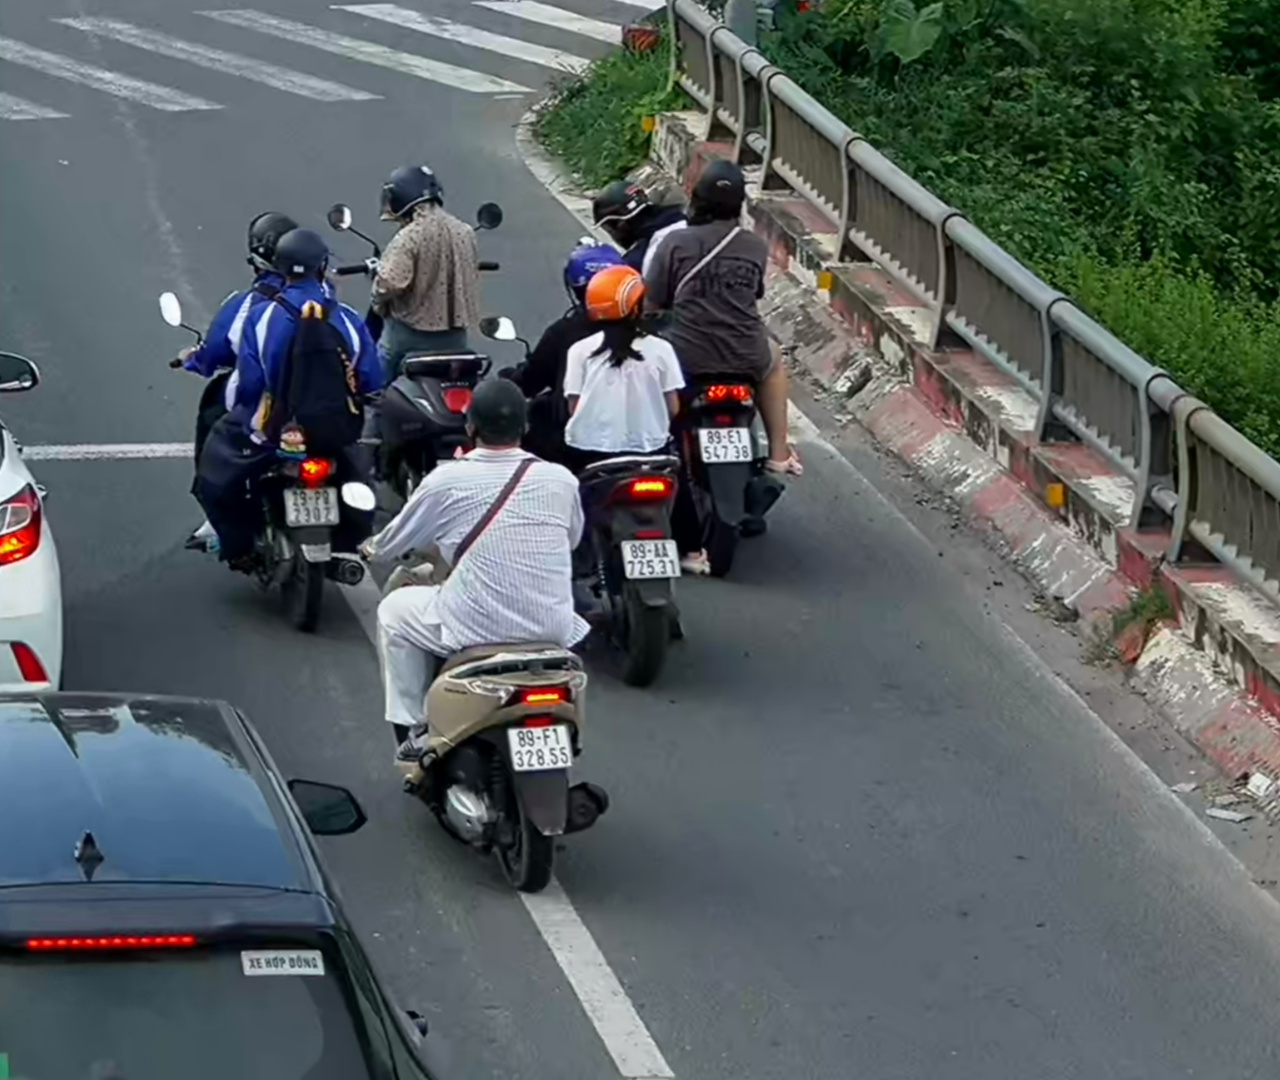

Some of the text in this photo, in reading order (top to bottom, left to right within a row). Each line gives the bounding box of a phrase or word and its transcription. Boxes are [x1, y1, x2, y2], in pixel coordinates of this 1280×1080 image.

[706, 430, 742, 445] 89-E1
[629, 542, 669, 559] 89-AA
[627, 559, 676, 577] 725.31
[517, 728, 560, 748] 89-F1
[514, 746, 569, 768] 328.55
[248, 957, 263, 969] XE
